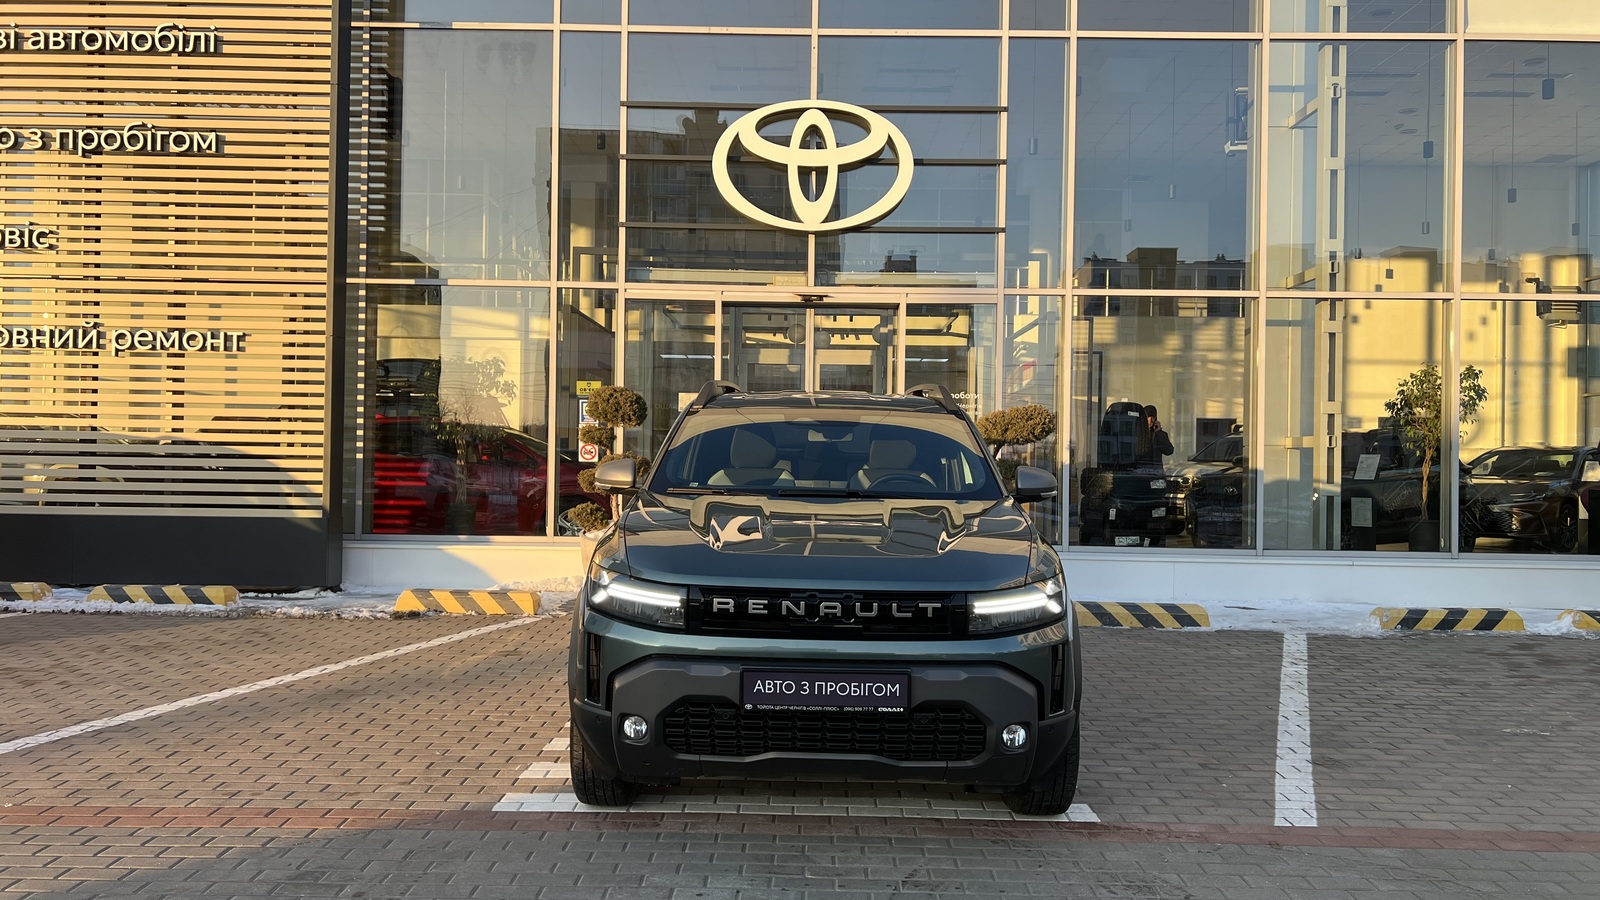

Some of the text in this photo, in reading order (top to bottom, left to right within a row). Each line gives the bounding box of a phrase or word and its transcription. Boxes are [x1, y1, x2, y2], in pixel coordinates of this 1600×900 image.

[28, 22, 216, 53] автомобілі
[27, 128, 43, 150] з
[56, 121, 217, 156] пробігом
[0, 221, 50, 248] віс
[111, 328, 244, 356] ремонт
[713, 597, 942, 618] RENAULT
[753, 679, 796, 694] АВТО
[814, 681, 900, 697] ПРОБІГОМ
